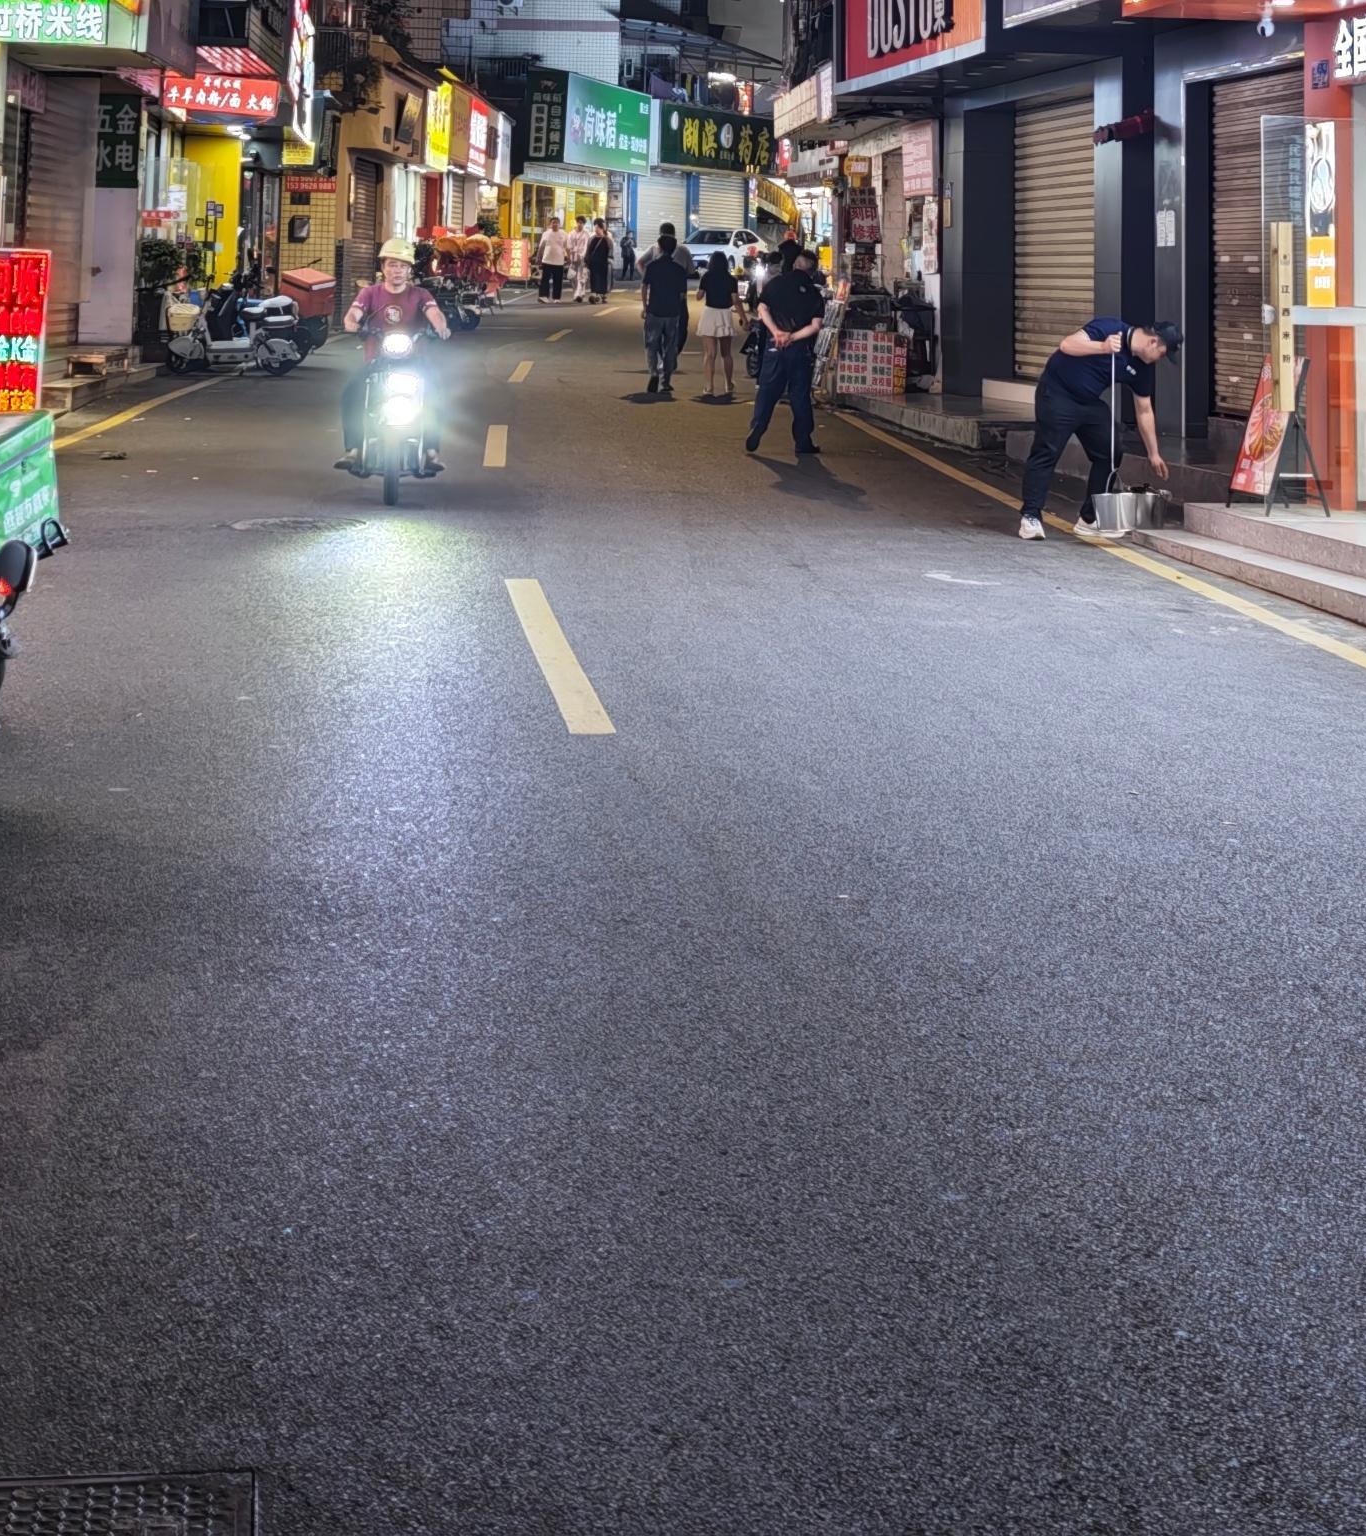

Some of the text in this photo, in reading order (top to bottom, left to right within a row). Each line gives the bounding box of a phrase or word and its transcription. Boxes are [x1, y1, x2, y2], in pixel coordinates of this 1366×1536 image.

[246, 94, 276, 112] 火锅
[682, 117, 718, 159] 湖滨
[738, 125, 771, 166] 药店
[849, 206, 878, 222] 刻印
[1280, 284, 1291, 364] 江西米粉
